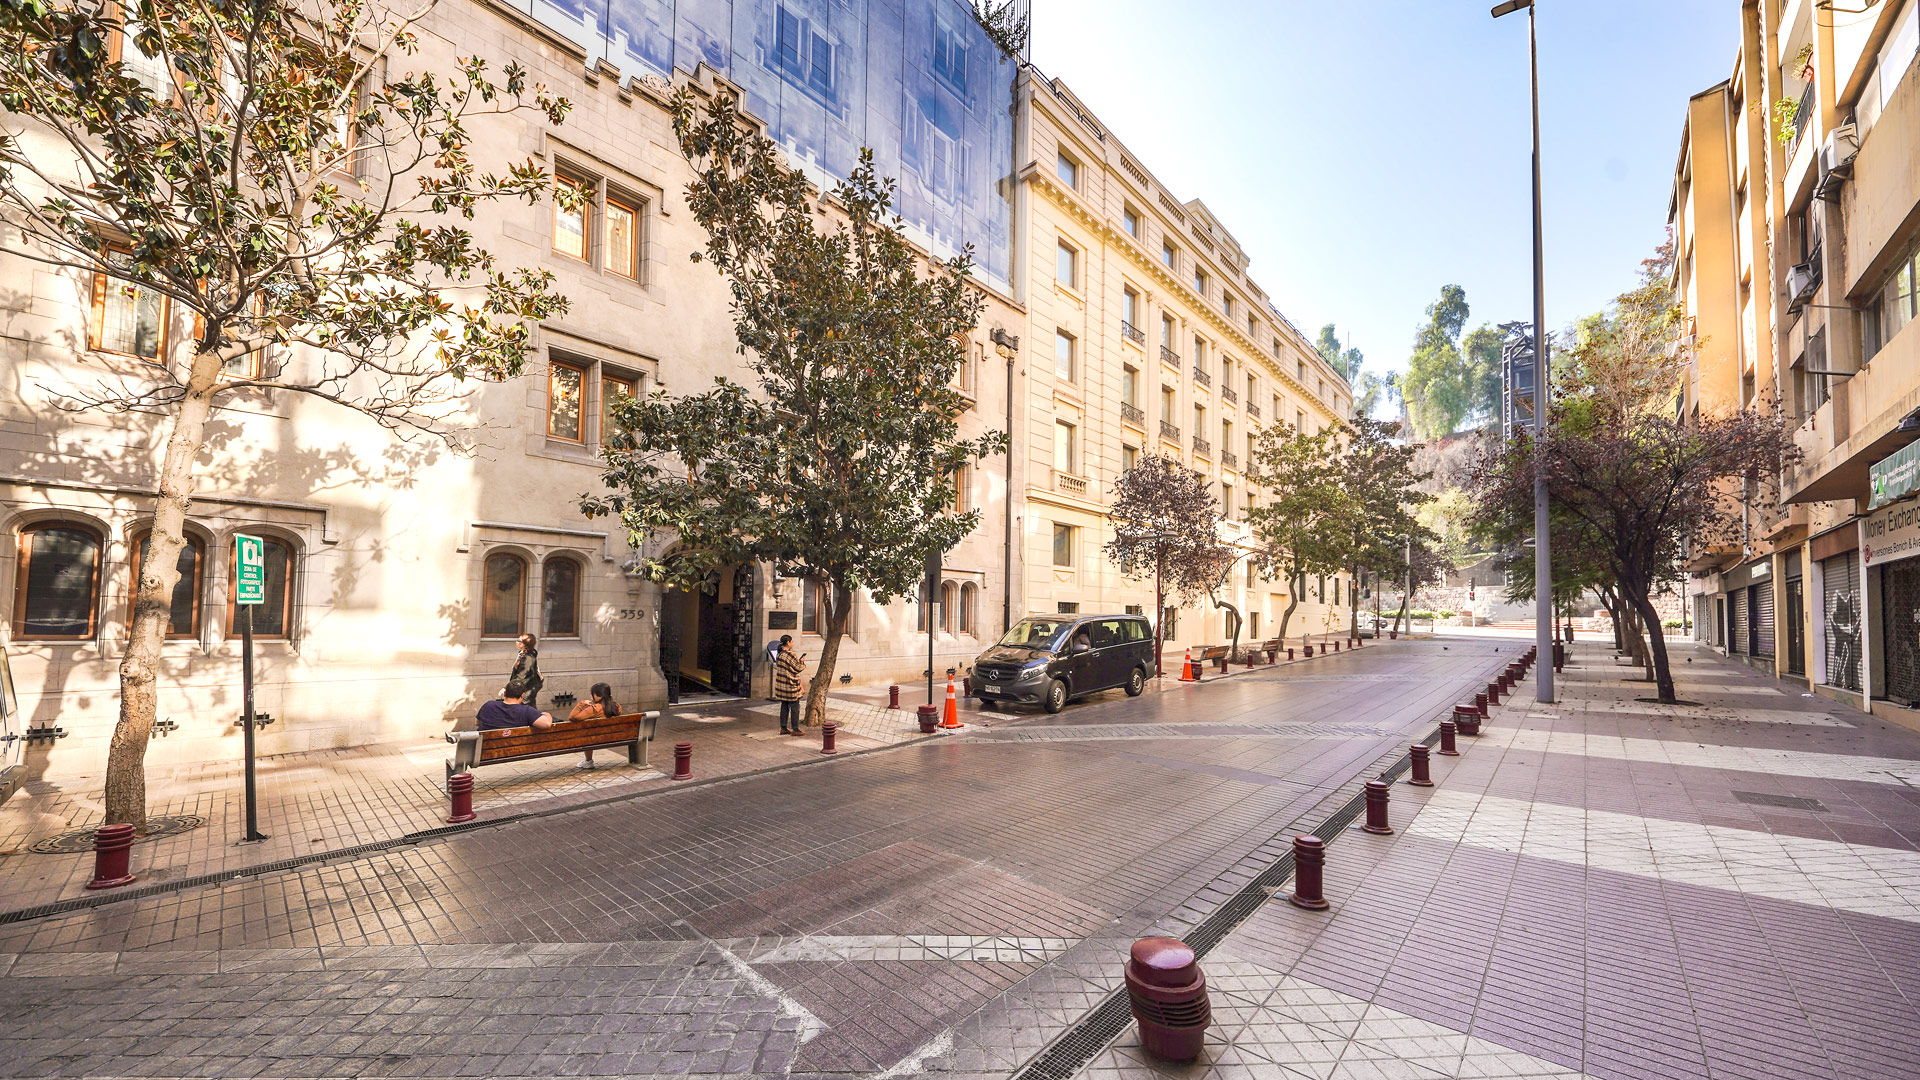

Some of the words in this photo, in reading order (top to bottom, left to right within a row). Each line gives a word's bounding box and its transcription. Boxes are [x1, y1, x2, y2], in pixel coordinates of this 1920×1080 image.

[1864, 518, 1886, 539] Money
[1872, 546, 1892, 558] Inversiones
[1909, 538, 1912, 549] &
